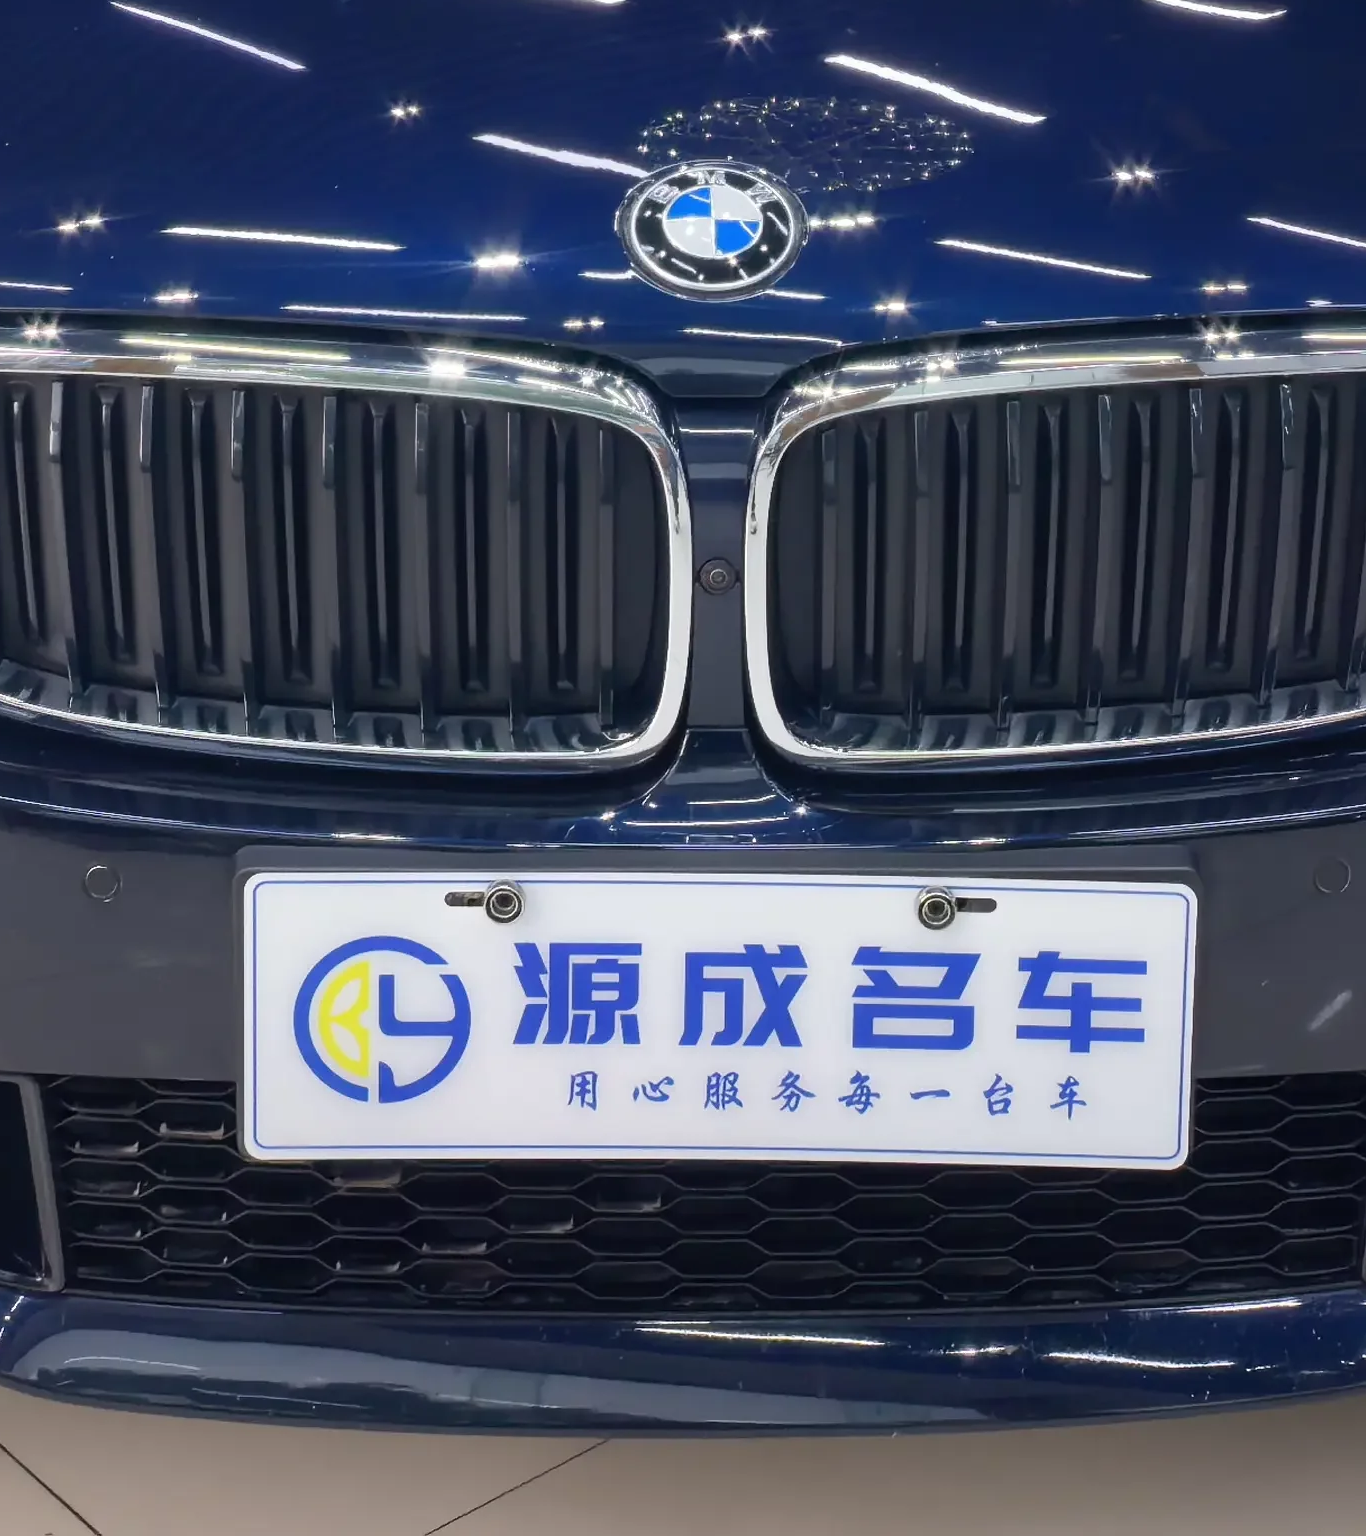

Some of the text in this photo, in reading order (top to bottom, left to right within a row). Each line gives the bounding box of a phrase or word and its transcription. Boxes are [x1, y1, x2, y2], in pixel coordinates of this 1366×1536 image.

[647, 168, 778, 206] BMW
[511, 940, 1147, 1054] 源成名车
[565, 1069, 1089, 1119] 用心服务每一台车
